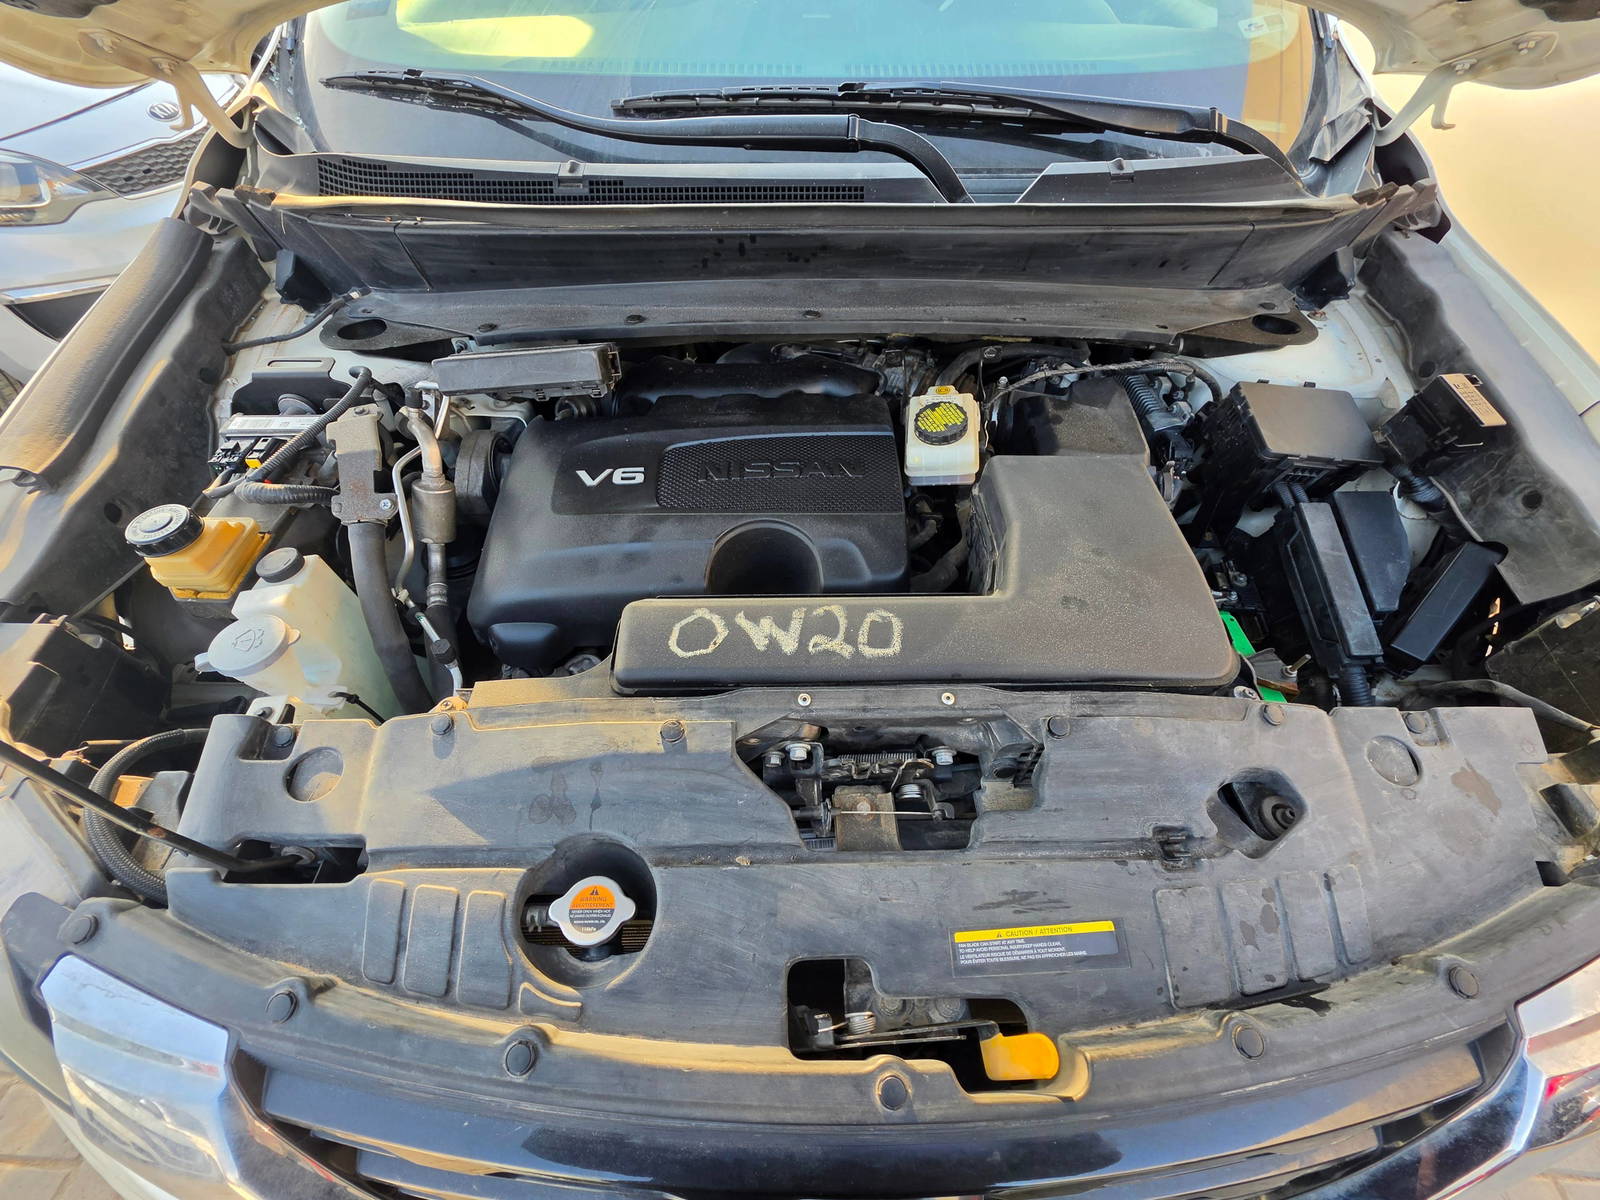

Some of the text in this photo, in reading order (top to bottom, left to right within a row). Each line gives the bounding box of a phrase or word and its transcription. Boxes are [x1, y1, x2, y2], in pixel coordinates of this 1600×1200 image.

[575, 466, 645, 488] V6
[699, 457, 865, 482] NISSAN
[1005, 929, 1033, 937] CAUTION
[1040, 926, 1072, 935] ATTENTION
